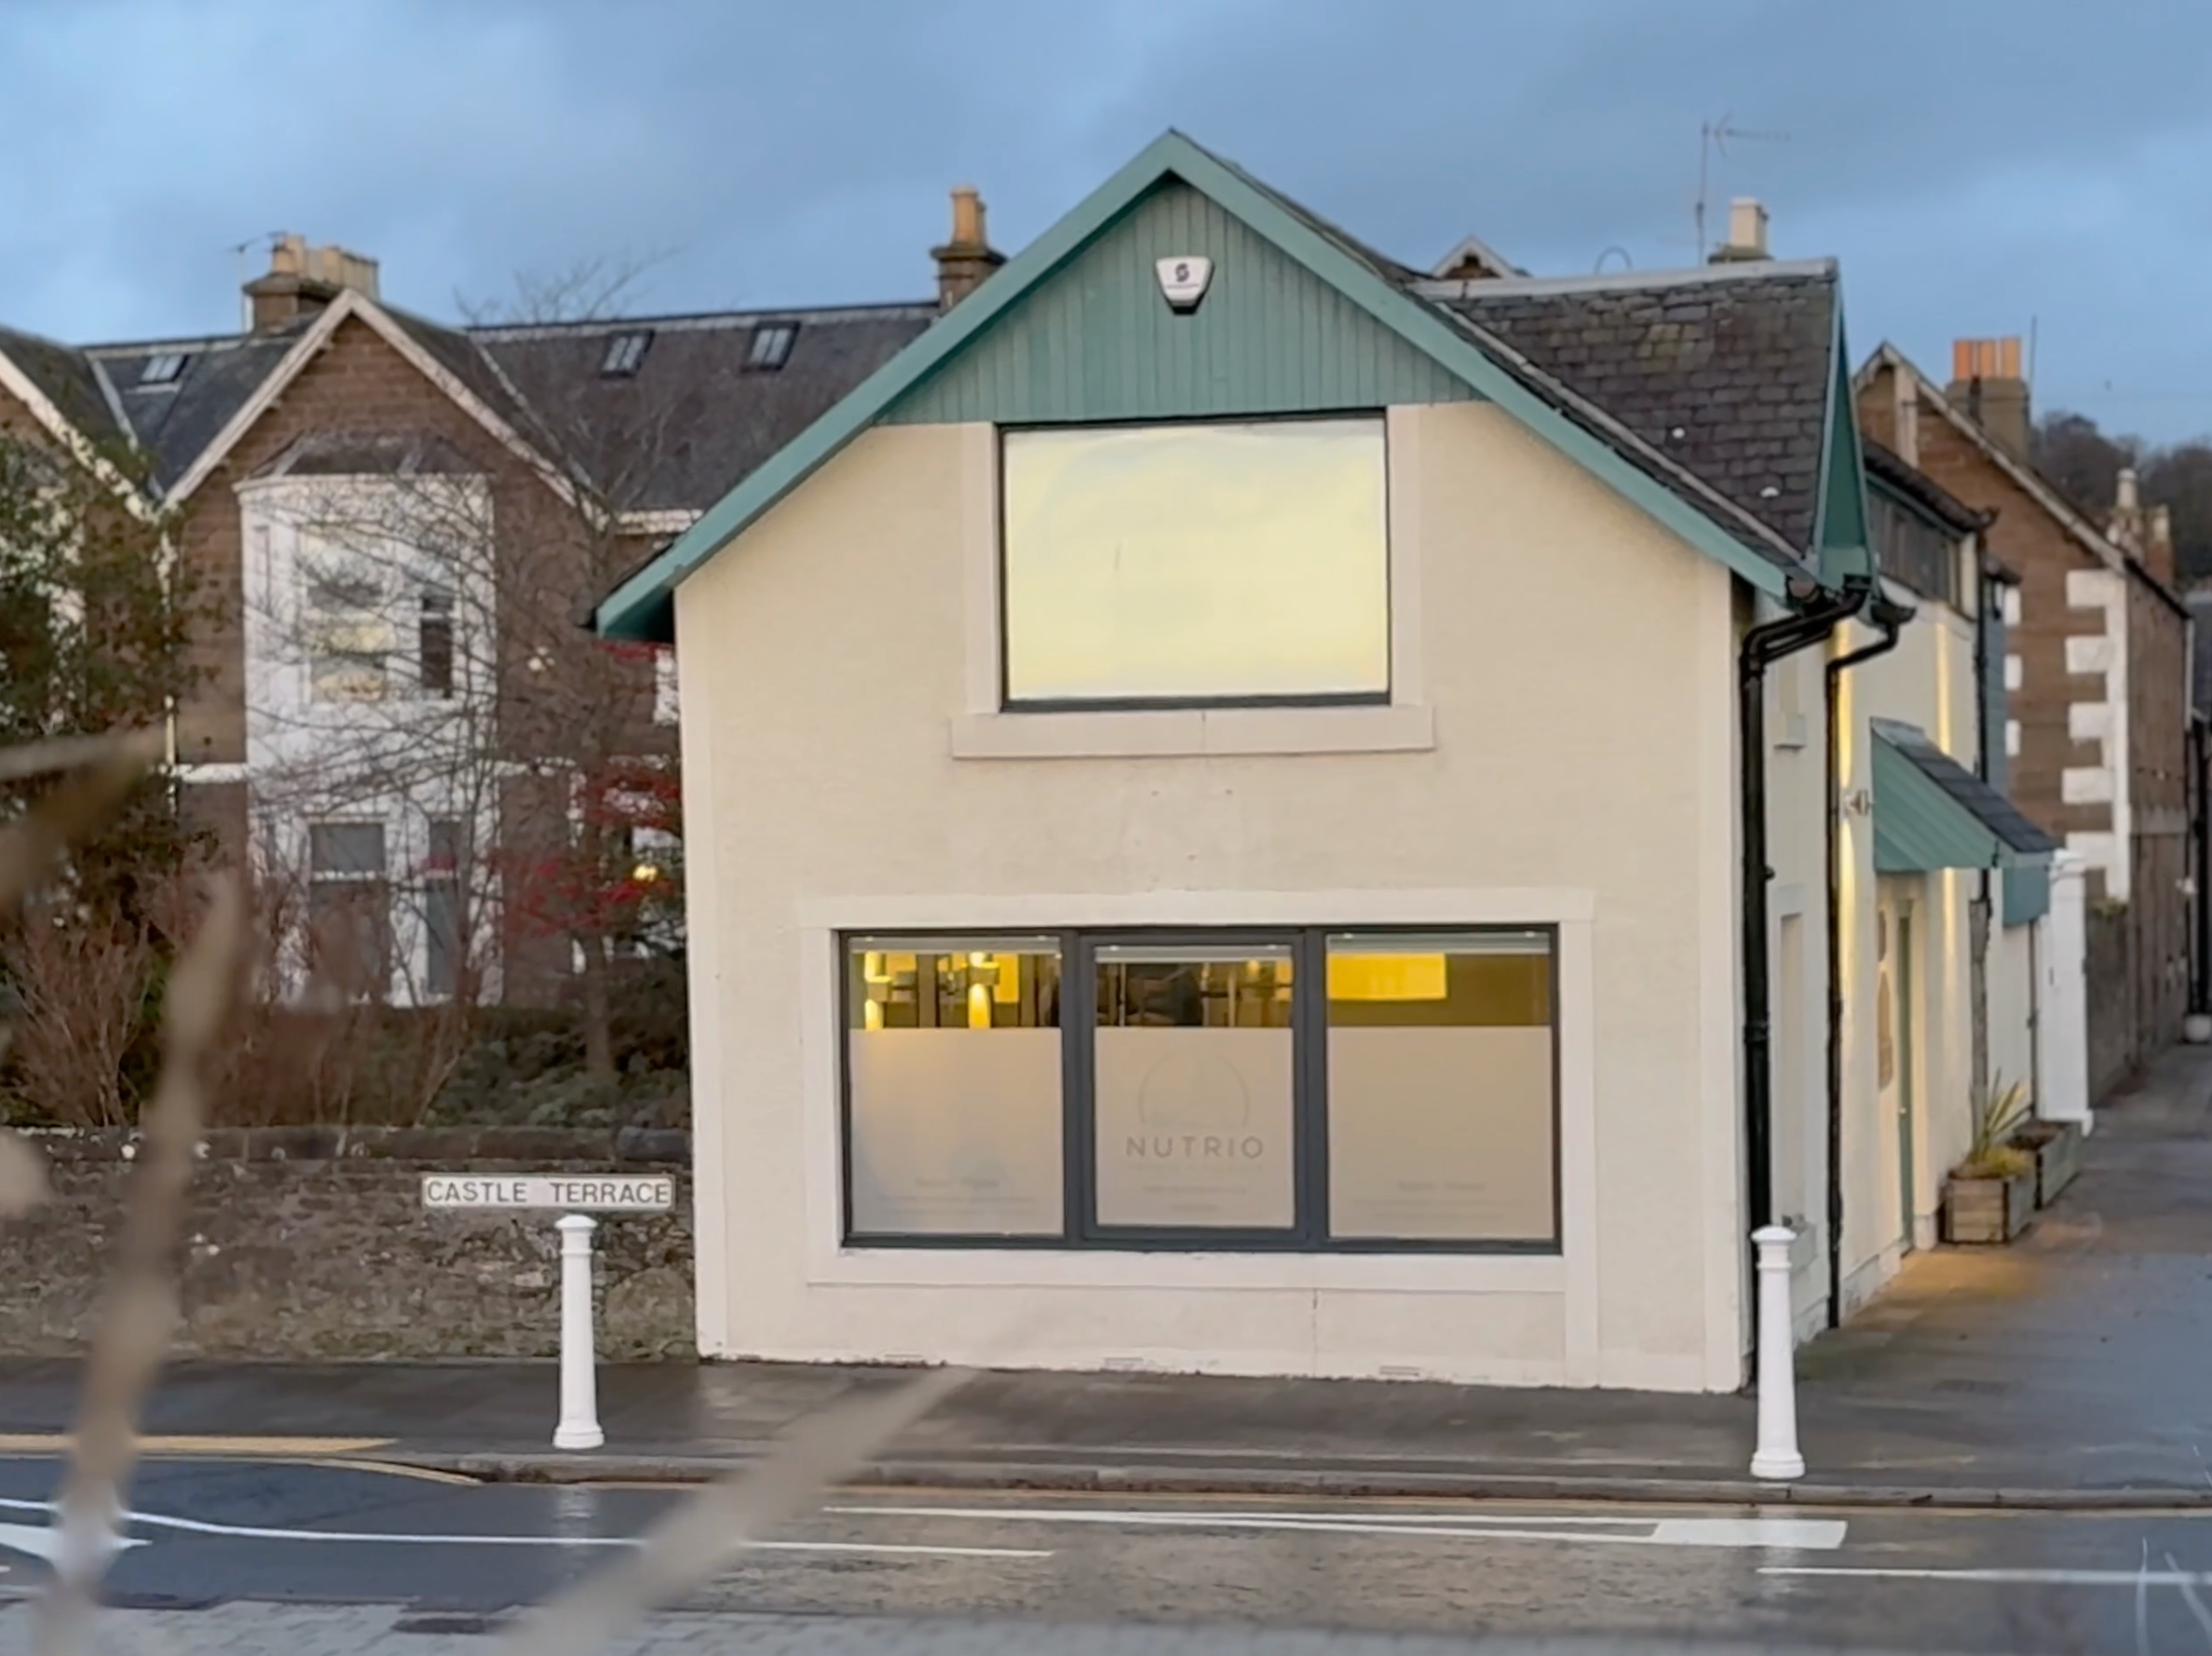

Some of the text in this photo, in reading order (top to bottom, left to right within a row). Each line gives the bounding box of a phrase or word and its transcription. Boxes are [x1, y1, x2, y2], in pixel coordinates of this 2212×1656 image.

[1126, 1135, 1264, 1160] NUTRIO
[427, 1180, 670, 1204] CASTLE TERRACE
